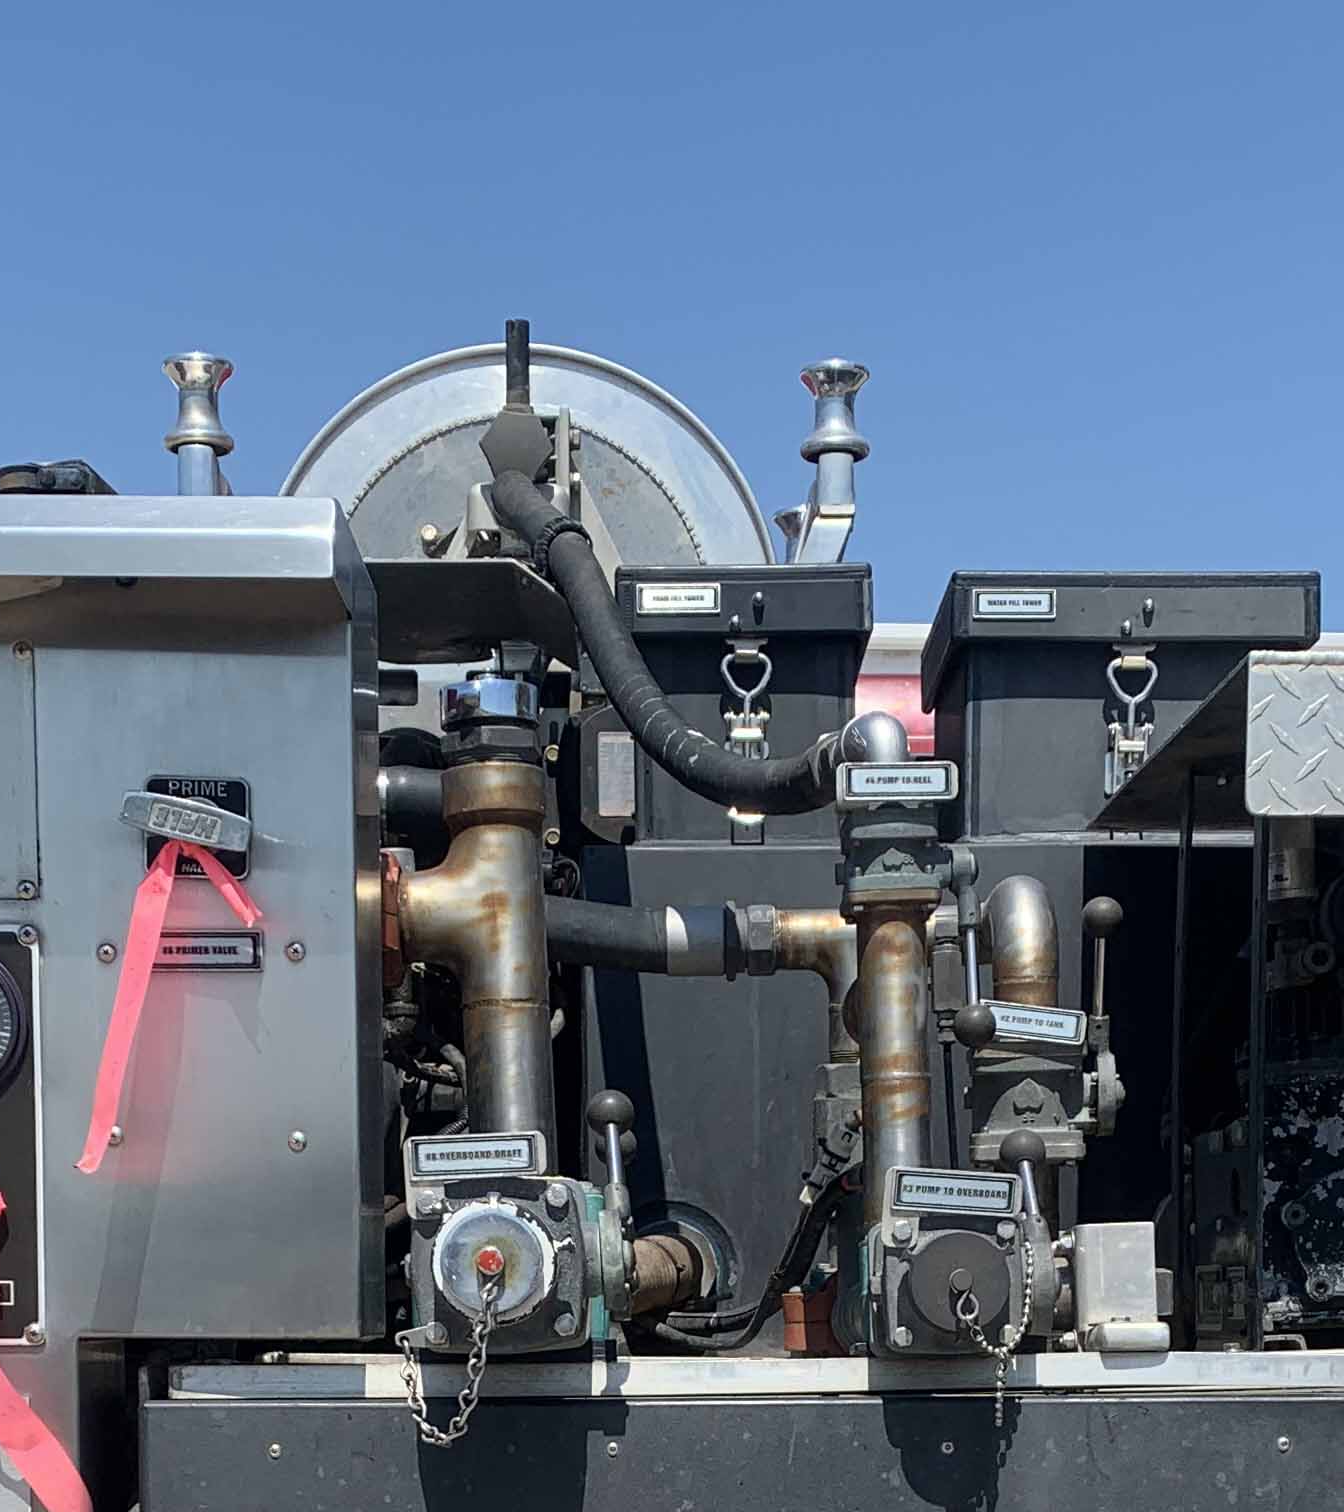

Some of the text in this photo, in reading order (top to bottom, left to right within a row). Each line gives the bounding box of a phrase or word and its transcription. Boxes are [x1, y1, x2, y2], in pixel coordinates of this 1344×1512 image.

[168, 780, 228, 797] PRIME
[181, 863, 207, 873] HAL
[440, 1150, 492, 1160] OVERBOARD
[916, 1185, 941, 1194] PUMP
[956, 1188, 1008, 1200] OVERBOARD
